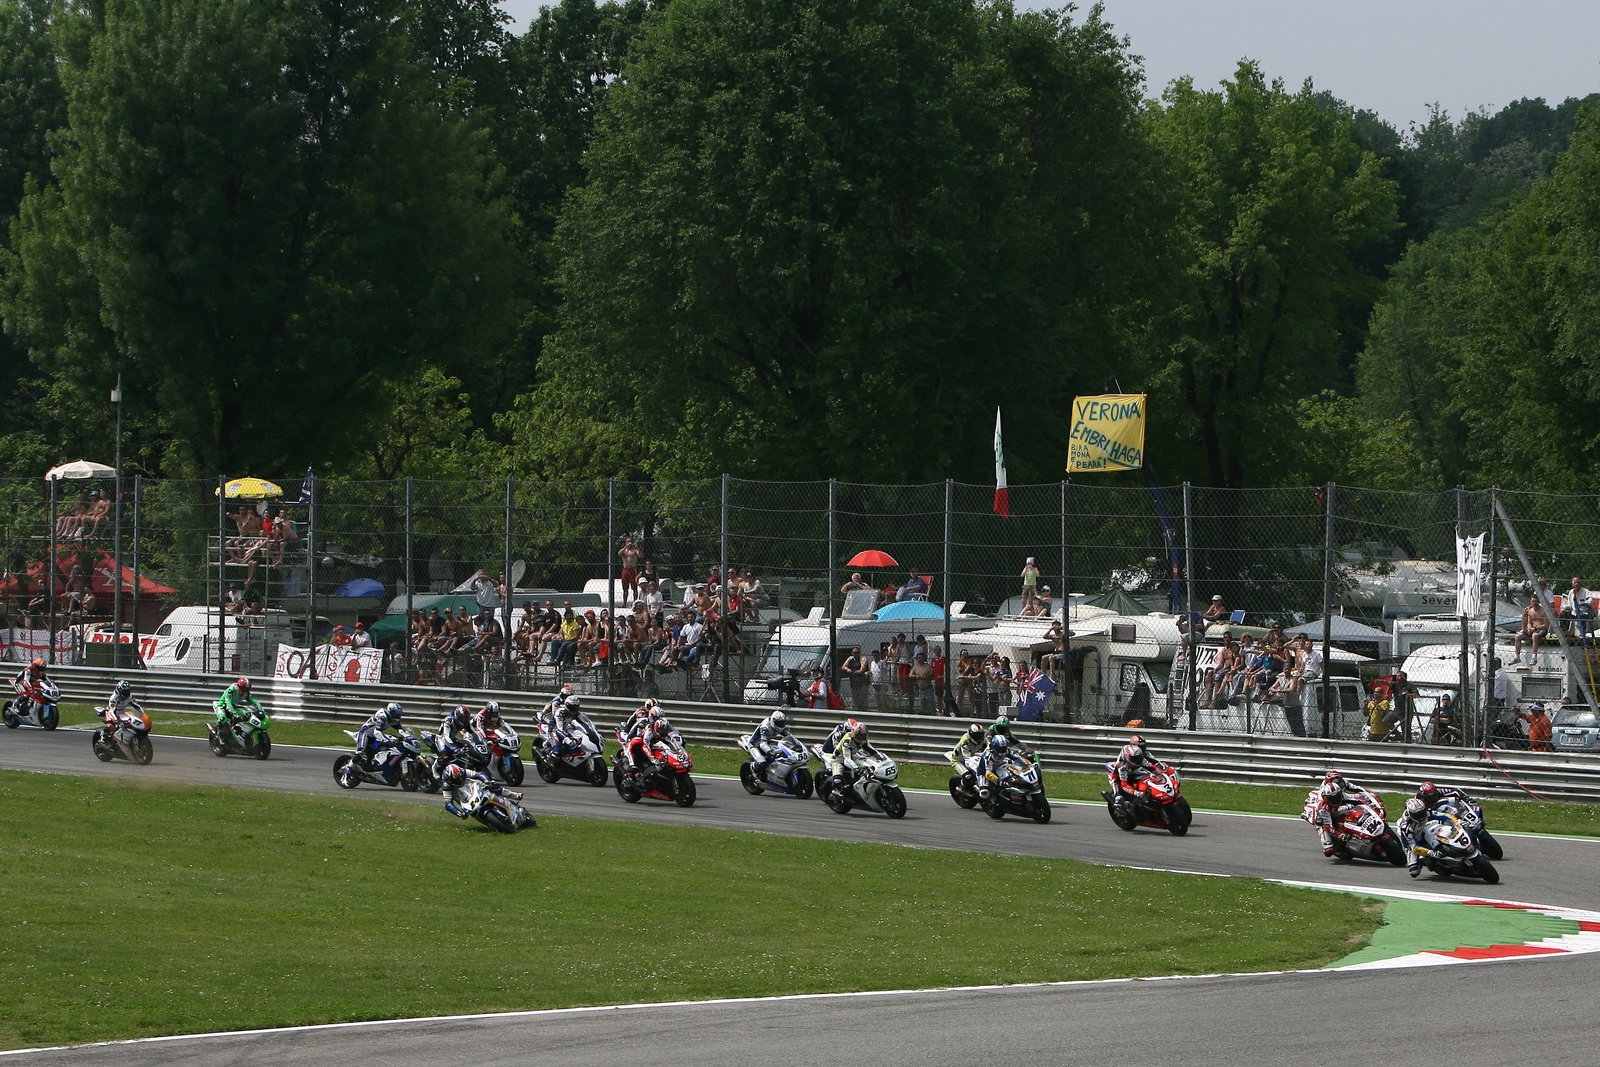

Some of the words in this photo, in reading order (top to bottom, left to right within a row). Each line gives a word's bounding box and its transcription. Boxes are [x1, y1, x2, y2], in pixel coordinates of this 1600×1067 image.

[1077, 401, 1141, 421] VERONA
[1110, 441, 1141, 465] HAGA
[885, 766, 896, 776] 65
[1164, 783, 1172, 793] 3
[1366, 819, 1382, 834] 84
